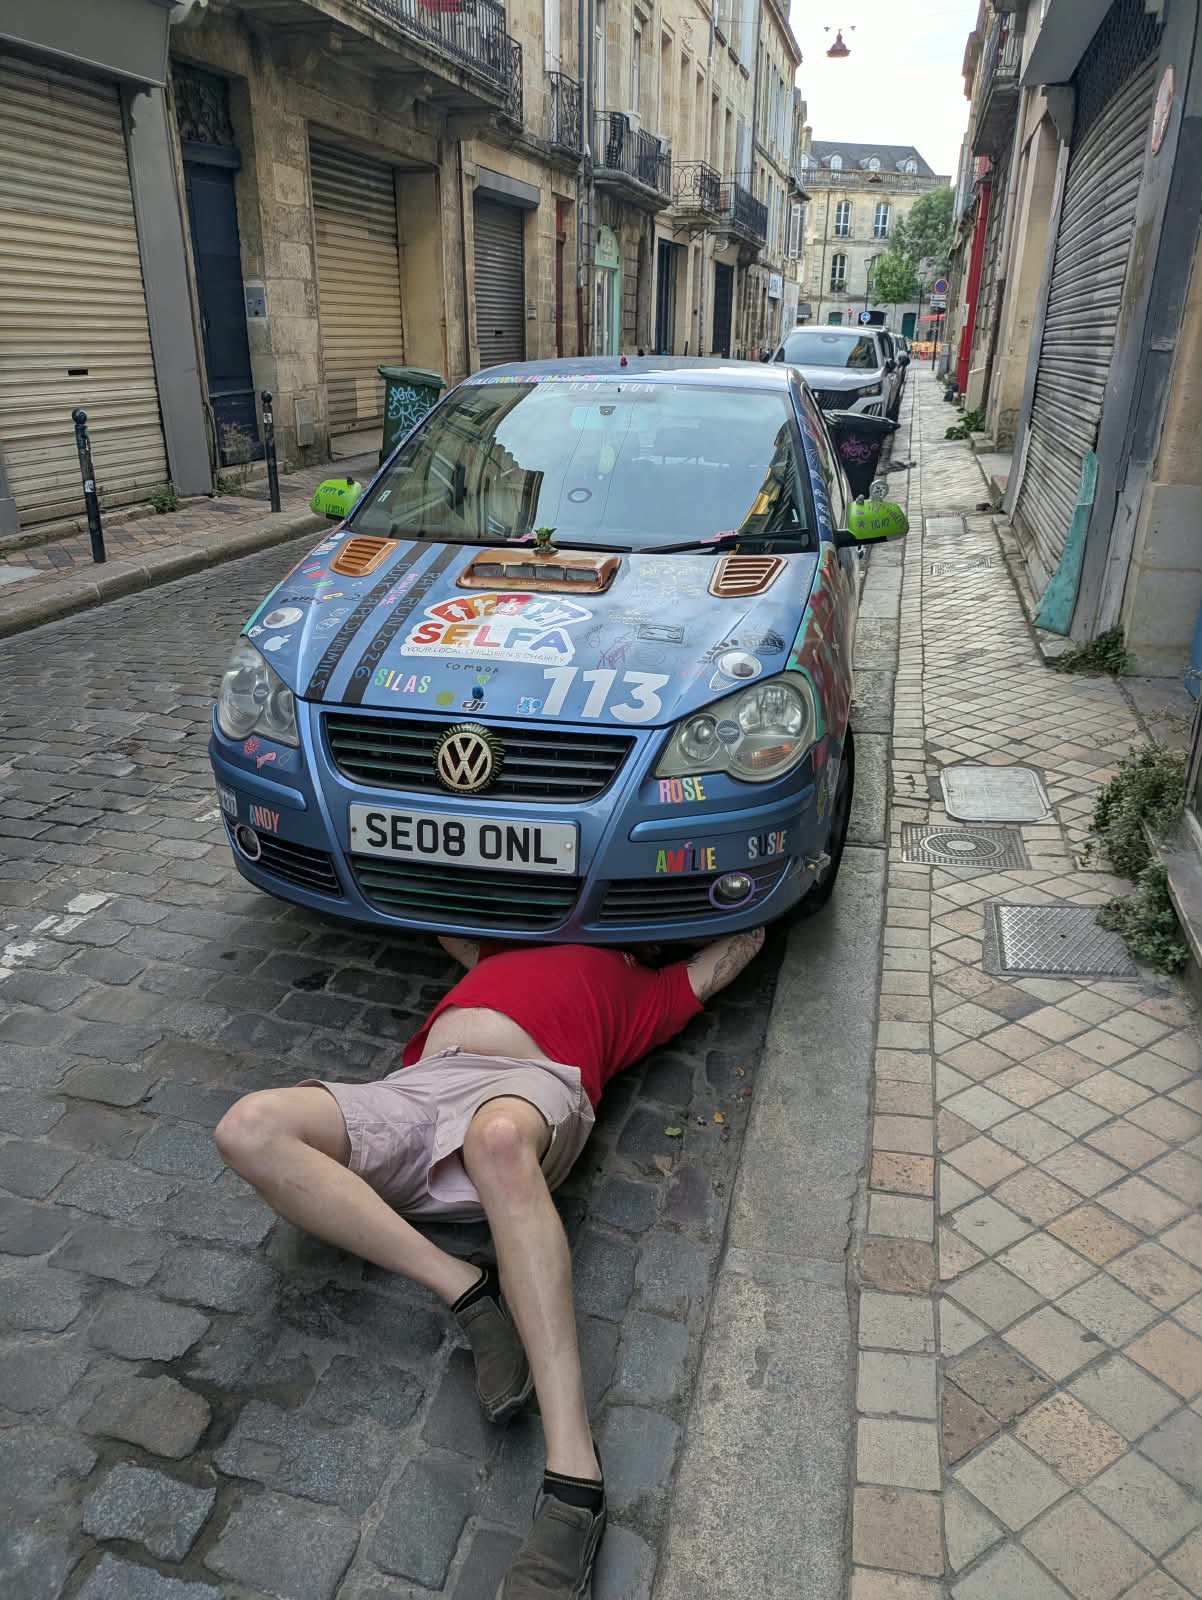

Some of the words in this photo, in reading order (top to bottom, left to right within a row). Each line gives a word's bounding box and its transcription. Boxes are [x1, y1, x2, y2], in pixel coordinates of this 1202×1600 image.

[354, 628, 397, 679] 2026
[411, 622, 569, 654] SELFA
[373, 667, 432, 694] SILAS
[541, 666, 670, 723] 113
[659, 776, 707, 804] ROSE
[249, 803, 280, 833] ANDY
[365, 812, 466, 857] SE08
[479, 824, 558, 865] ONL
[748, 829, 787, 860] SUSIE
